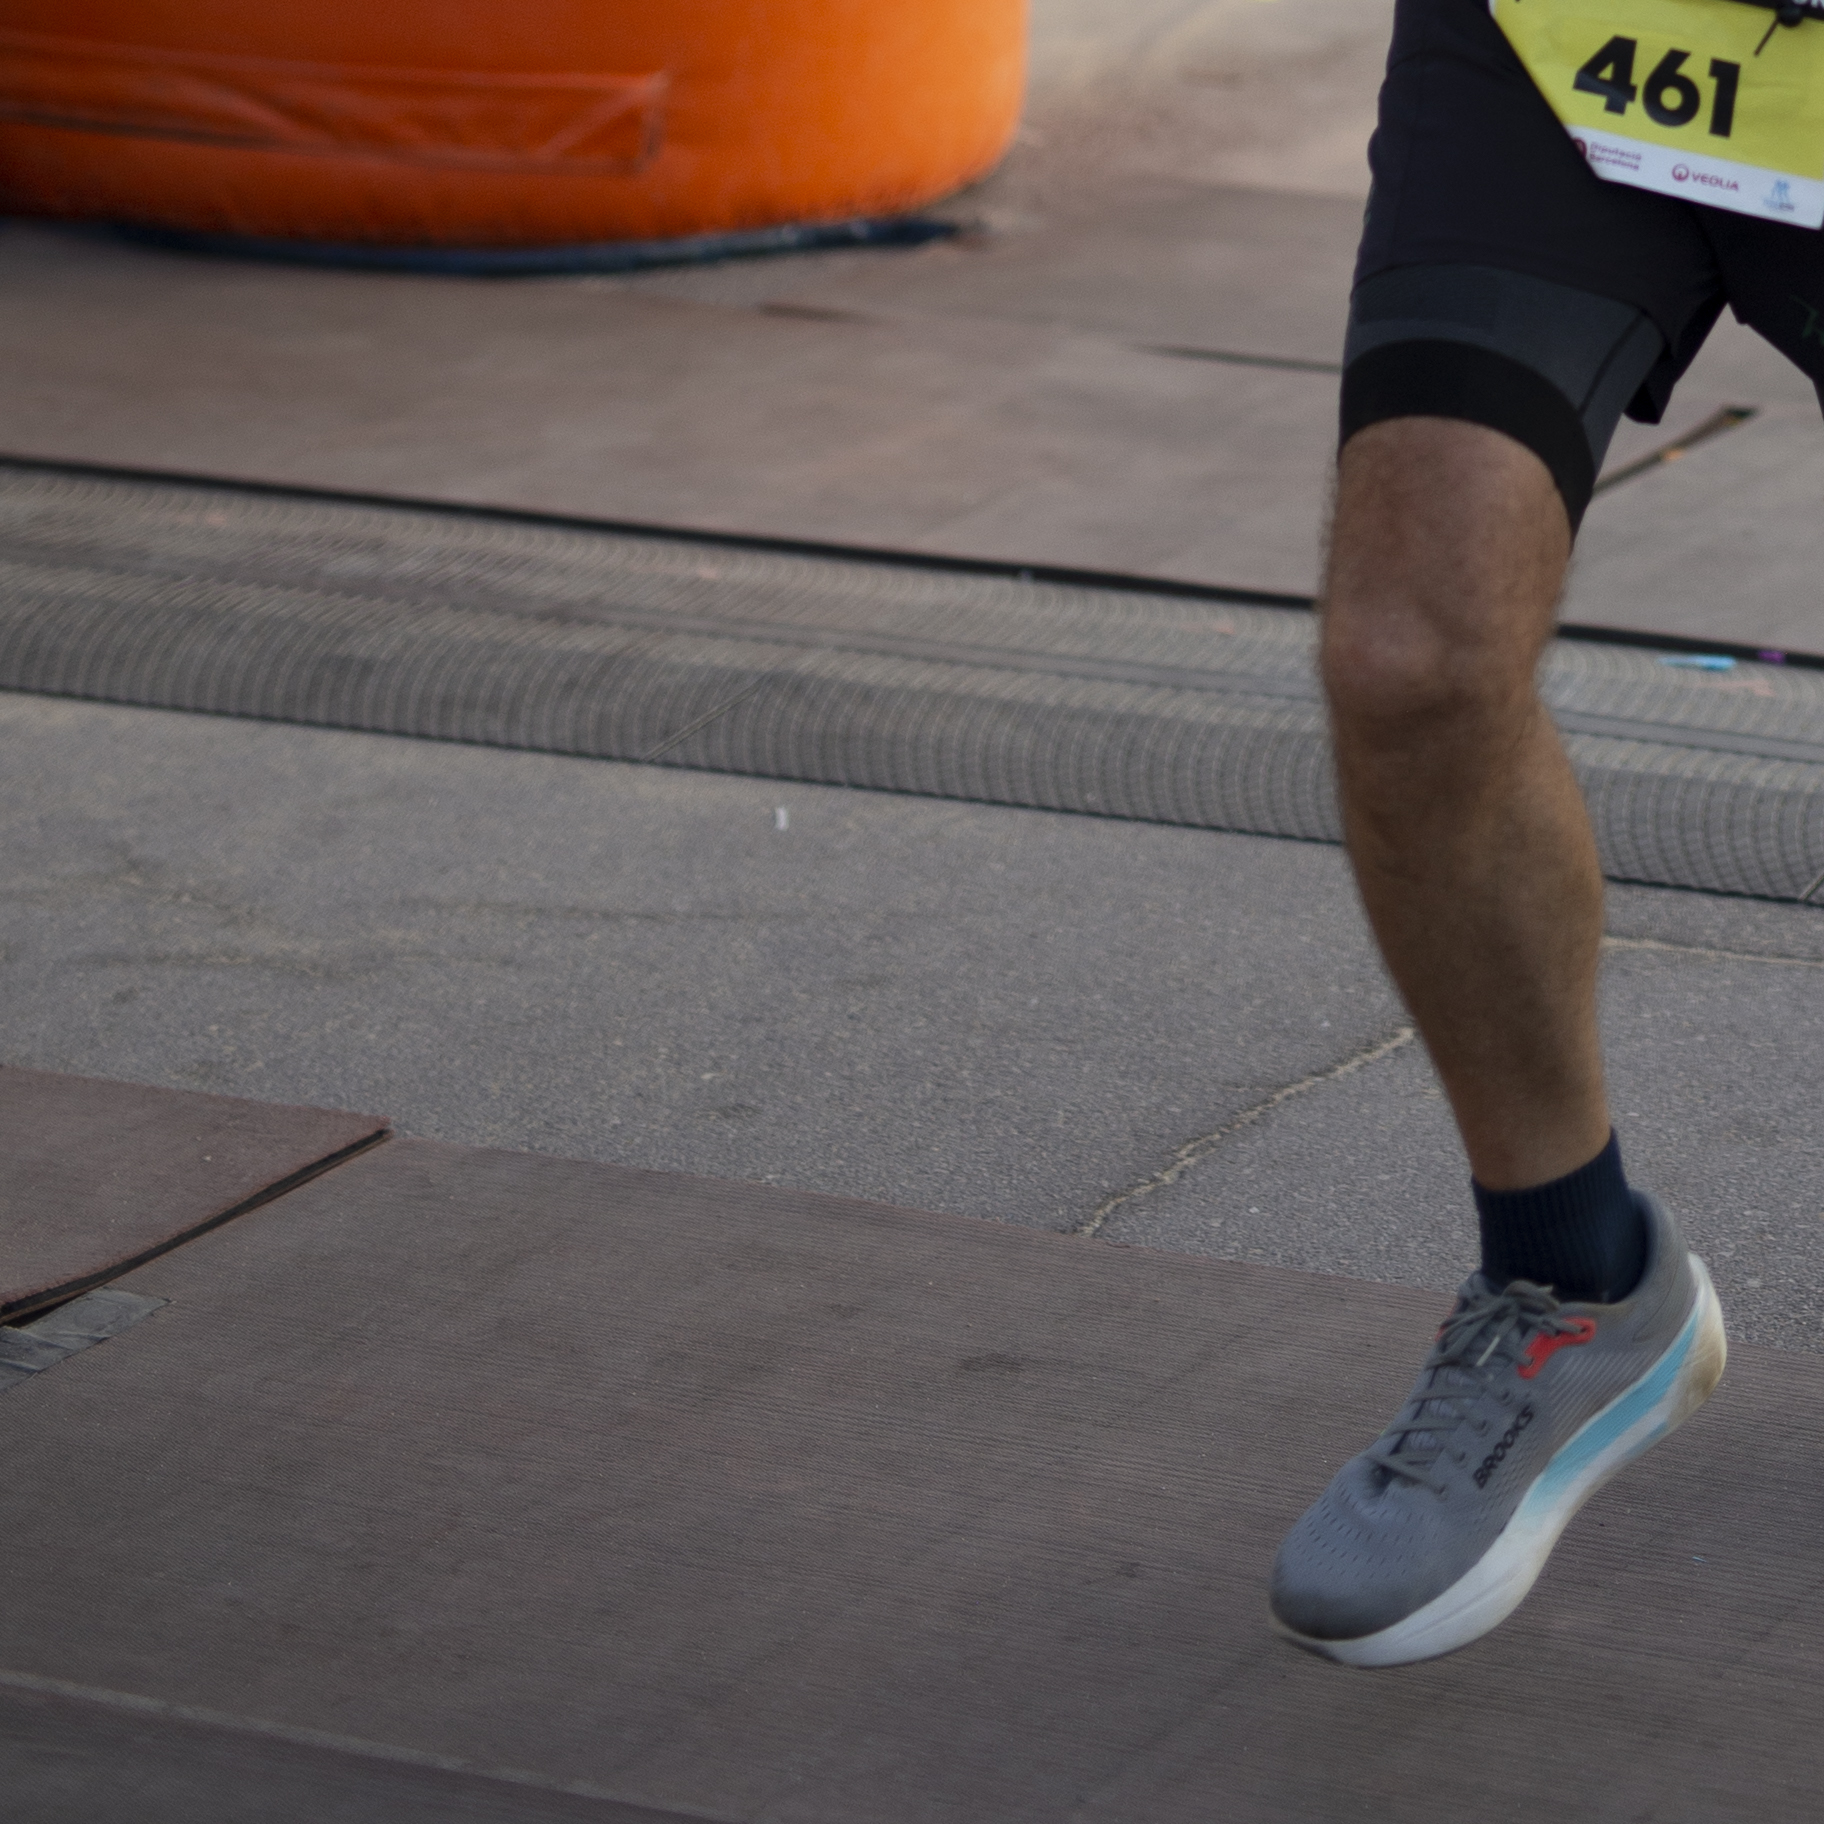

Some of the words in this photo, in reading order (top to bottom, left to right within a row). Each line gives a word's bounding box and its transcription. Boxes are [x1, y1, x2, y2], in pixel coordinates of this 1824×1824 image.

[1572, 35, 1741, 140] 461
[1691, 173, 1740, 192] VEOLIA
[1472, 1404, 1534, 1489] BROOKS
